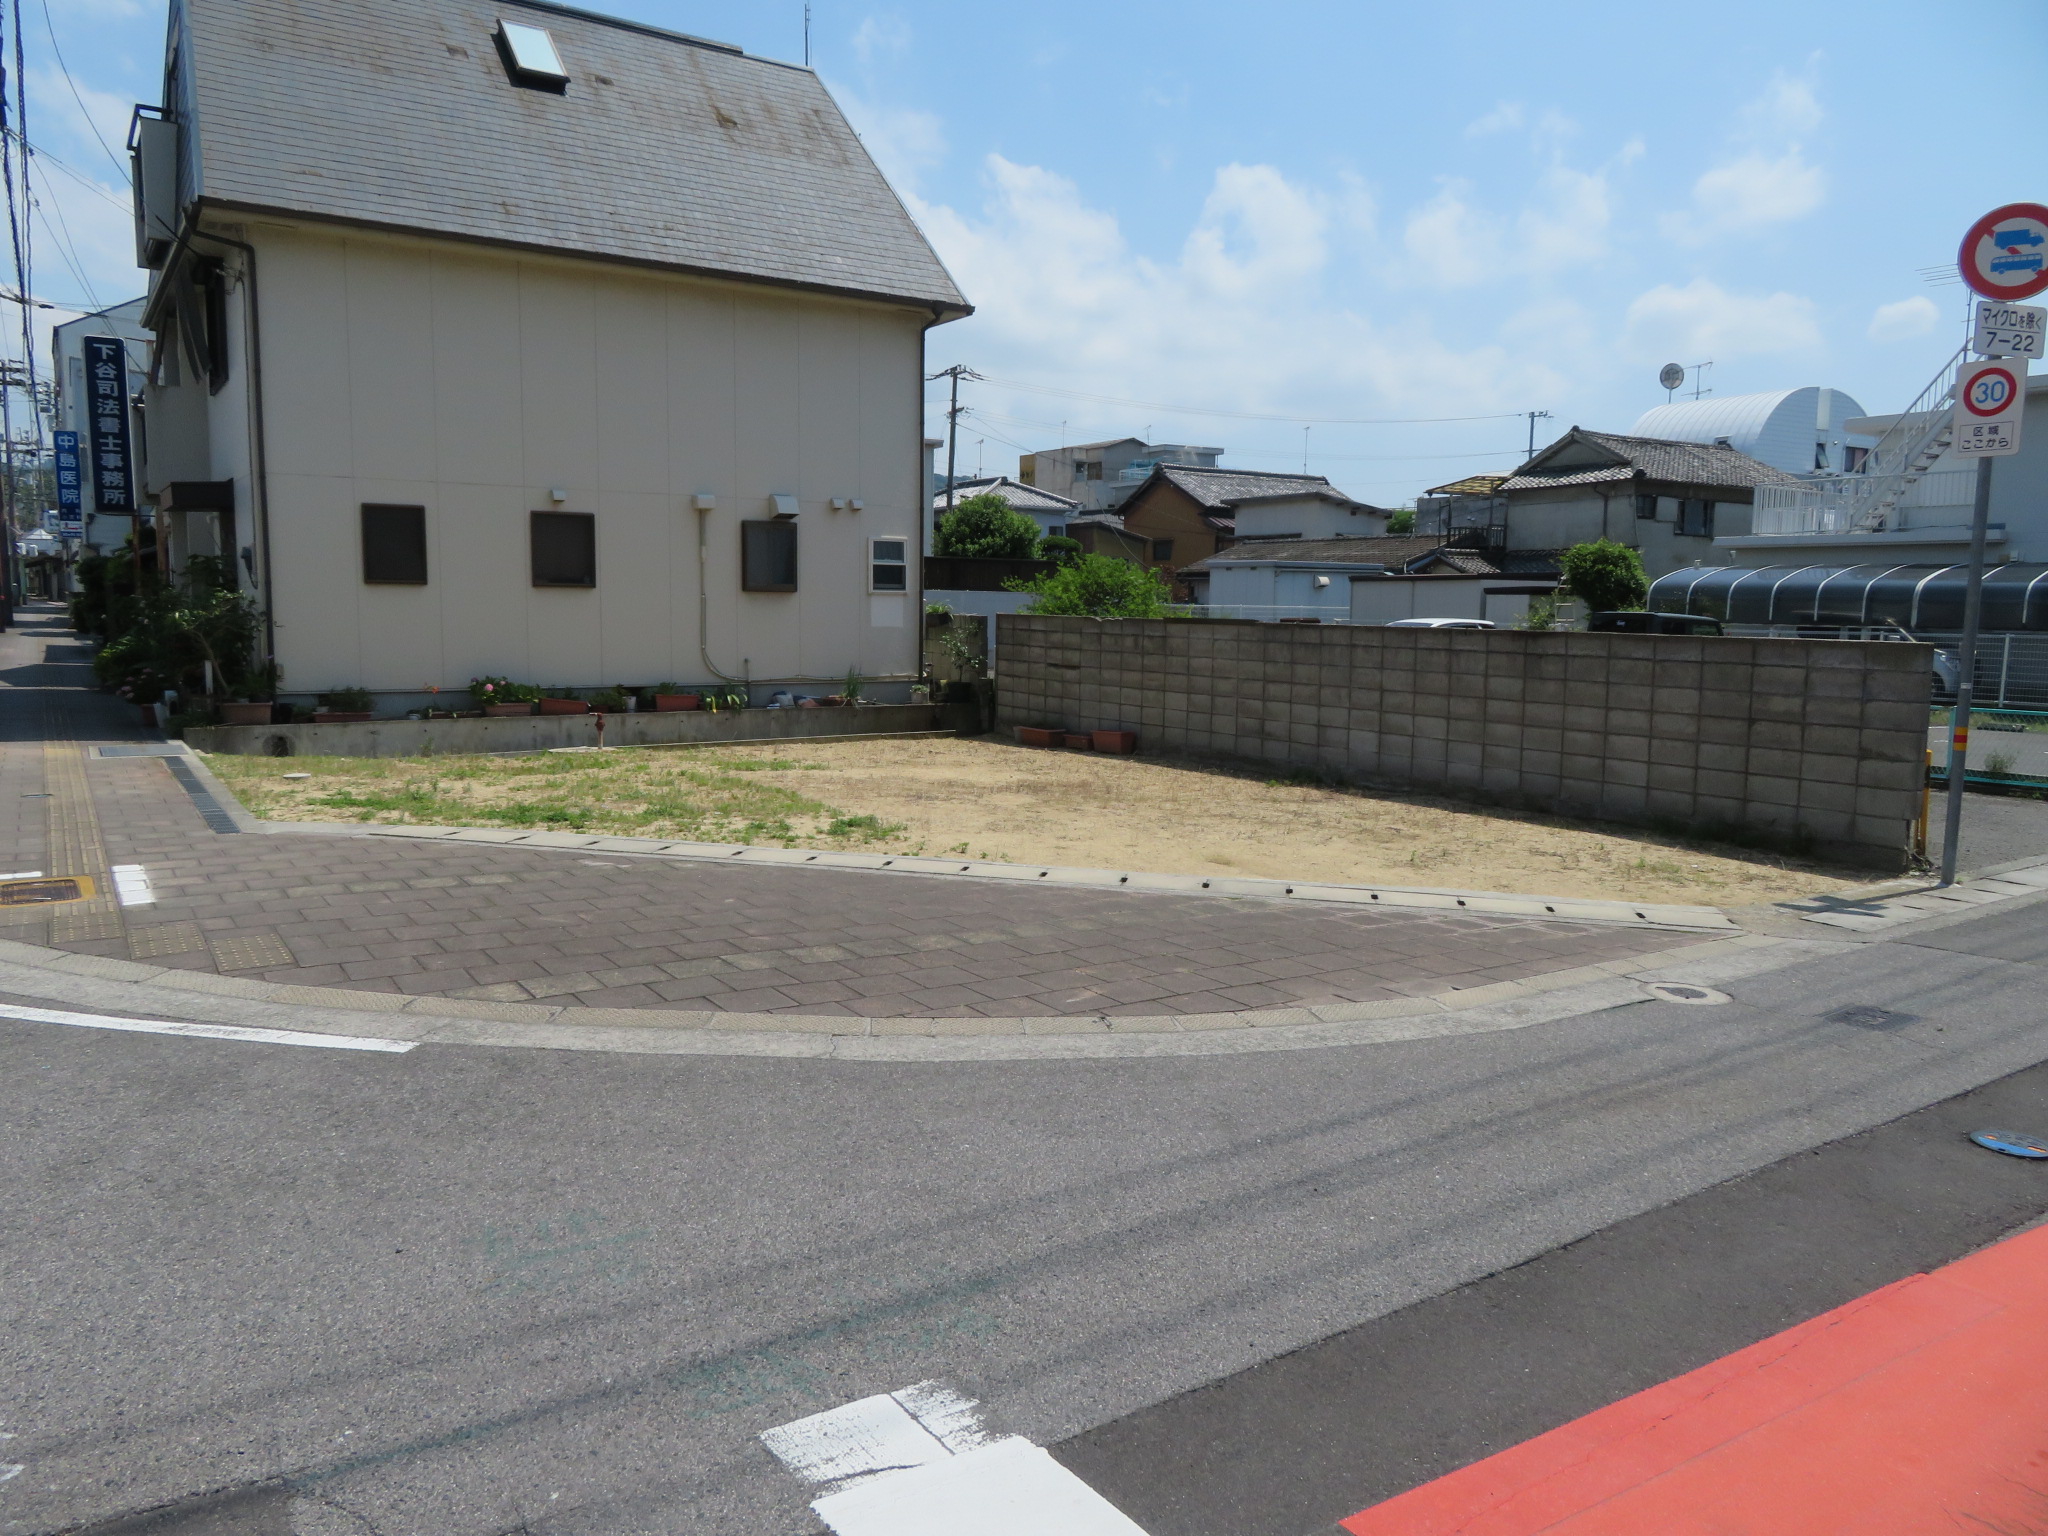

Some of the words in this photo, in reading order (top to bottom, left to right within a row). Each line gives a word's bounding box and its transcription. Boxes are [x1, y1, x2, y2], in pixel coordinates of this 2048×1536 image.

[1982, 308, 2042, 330] マイクロを除く
[1975, 380, 2006, 404] 30
[93, 343, 126, 505] 下谷司法書士事務所
[1973, 425, 1999, 437] 区域
[1962, 437, 2009, 450] ここから
[58, 434, 79, 503] 中島医院
